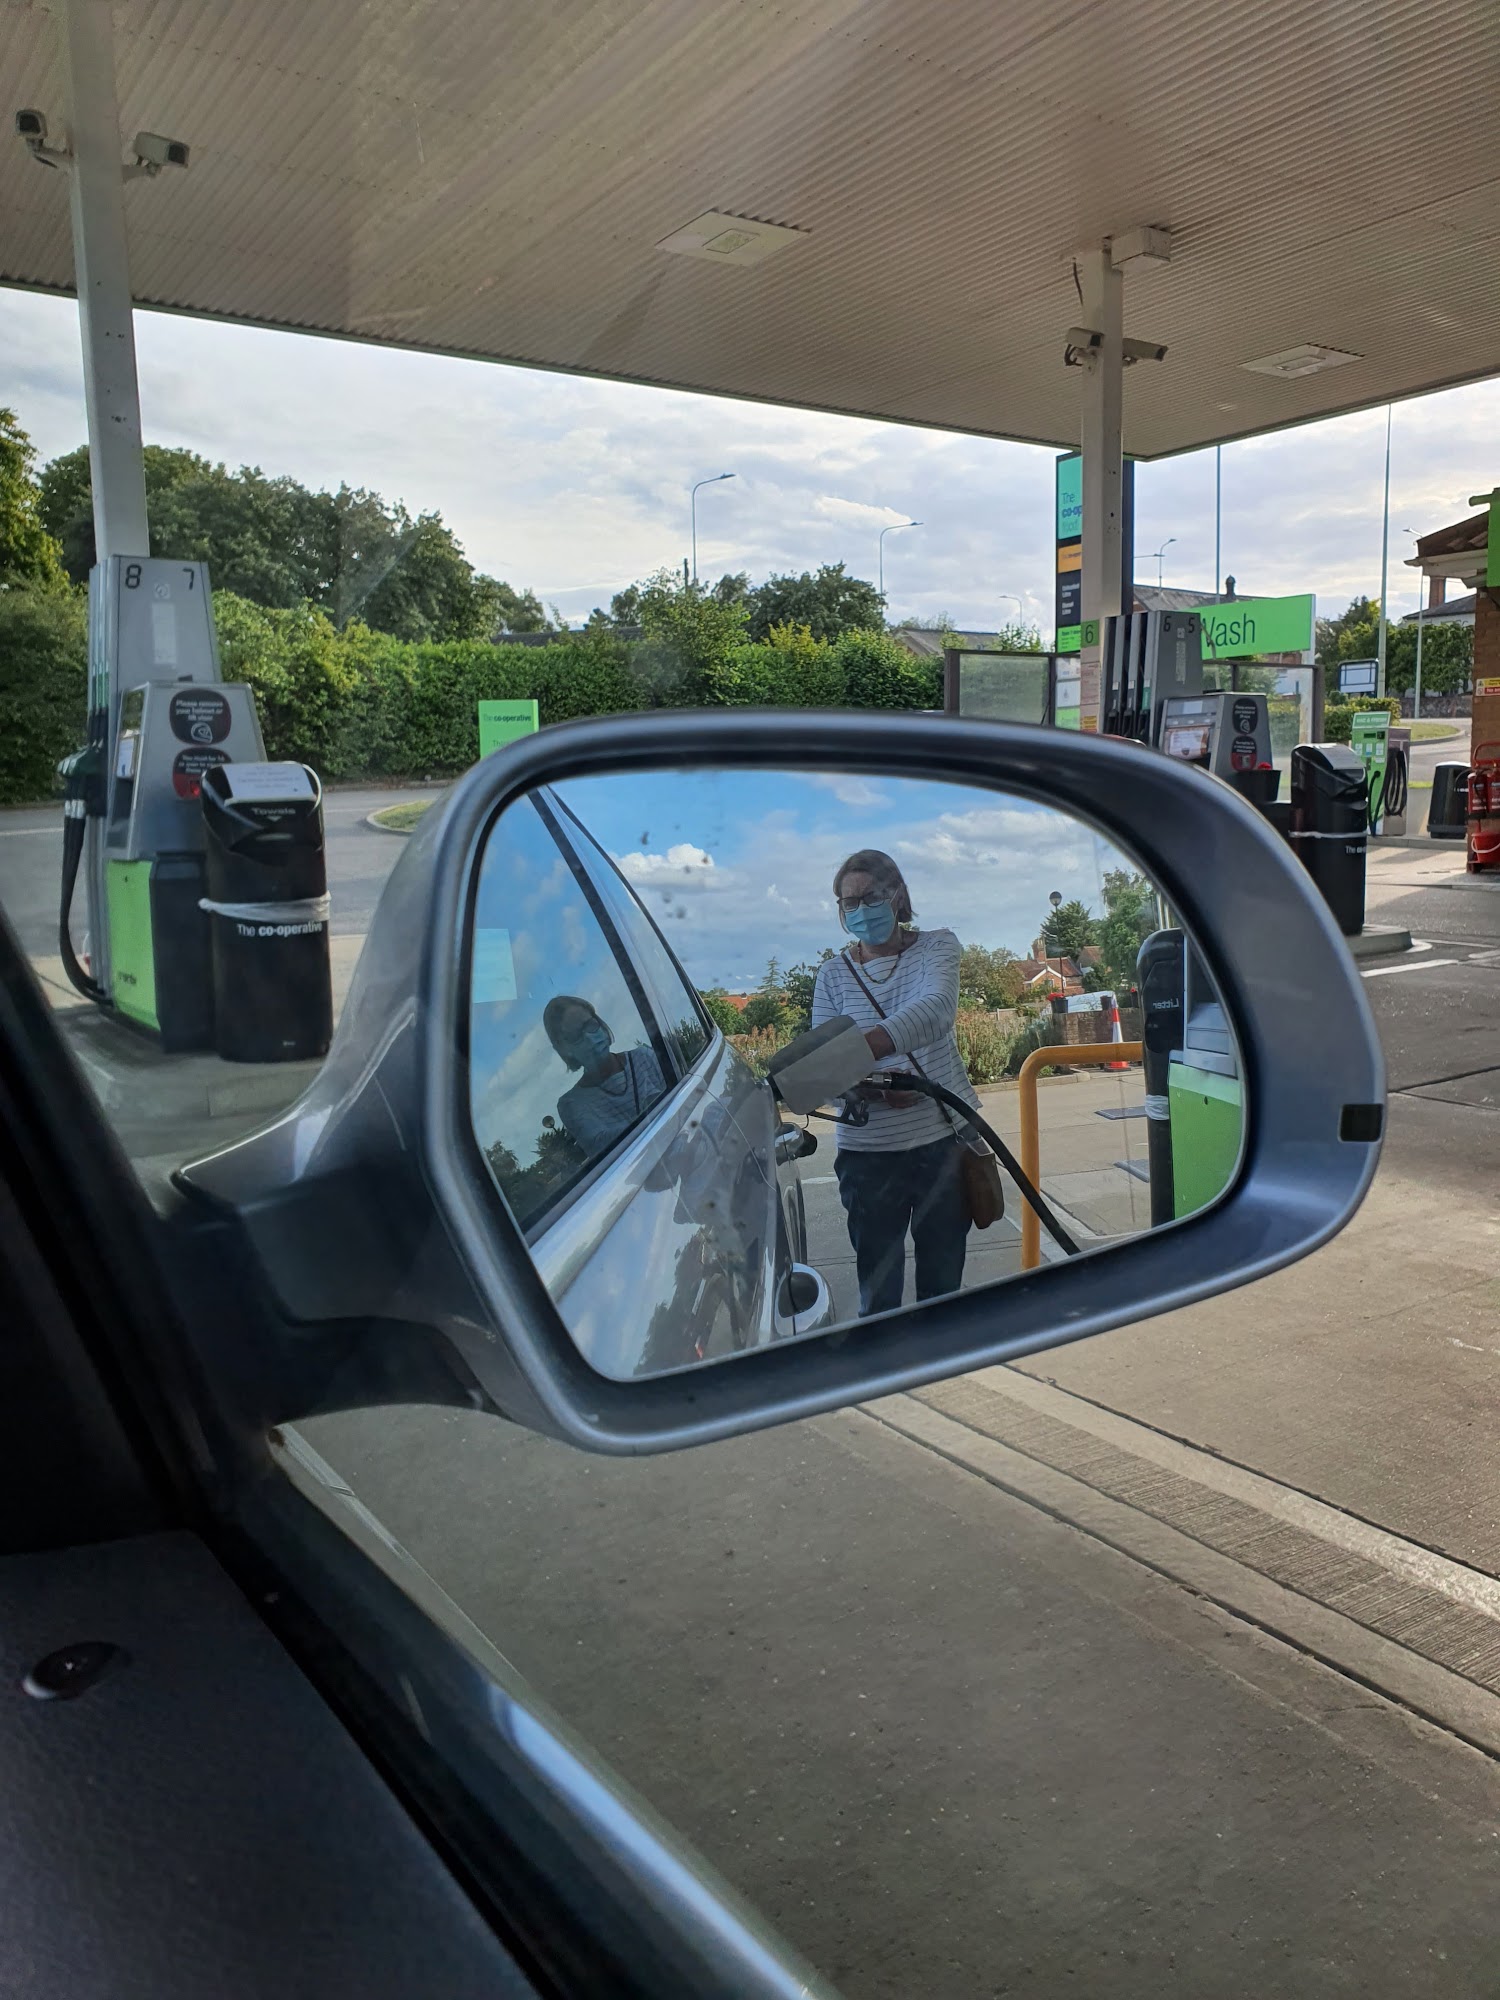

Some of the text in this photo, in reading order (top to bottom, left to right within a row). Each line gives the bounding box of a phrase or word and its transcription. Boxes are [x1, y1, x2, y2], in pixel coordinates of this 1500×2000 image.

[125, 564, 142, 589] 8
[182, 567, 195, 590] 7
[1163, 616, 1171, 632] 6
[1188, 617, 1195, 633] 5
[1085, 624, 1094, 644] 6
[237, 920, 323, 937] The co-operative
